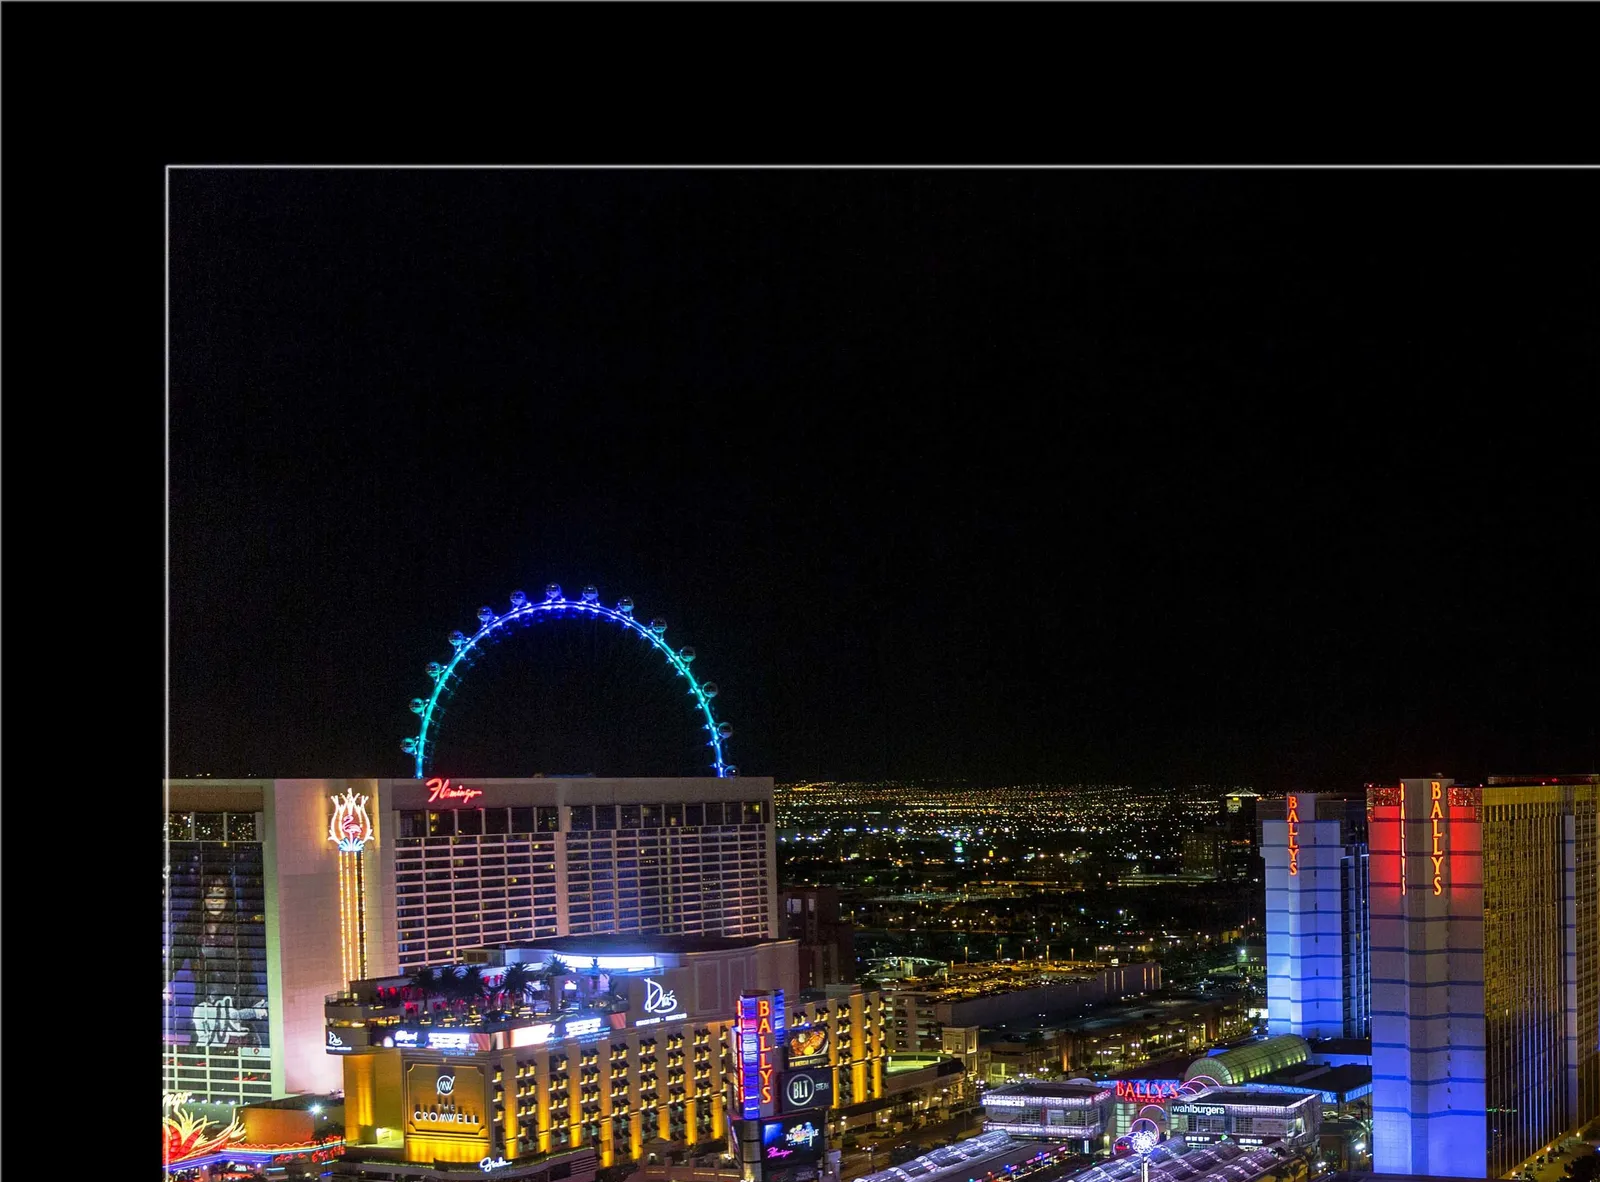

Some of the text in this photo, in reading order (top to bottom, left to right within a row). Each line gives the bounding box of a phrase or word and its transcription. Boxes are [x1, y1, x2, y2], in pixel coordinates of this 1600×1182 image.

[425, 778, 482, 803] Flamingo
[1287, 796, 1299, 876] BALLYS
[1430, 782, 1444, 896] BALLYS
[758, 1000, 773, 1104] BALLYS
[793, 1080, 809, 1099] BLT
[1116, 1081, 1178, 1099] BALLY'S
[414, 1111, 479, 1125] CROMWELL
[1172, 1104, 1225, 1116] wahlburgers
